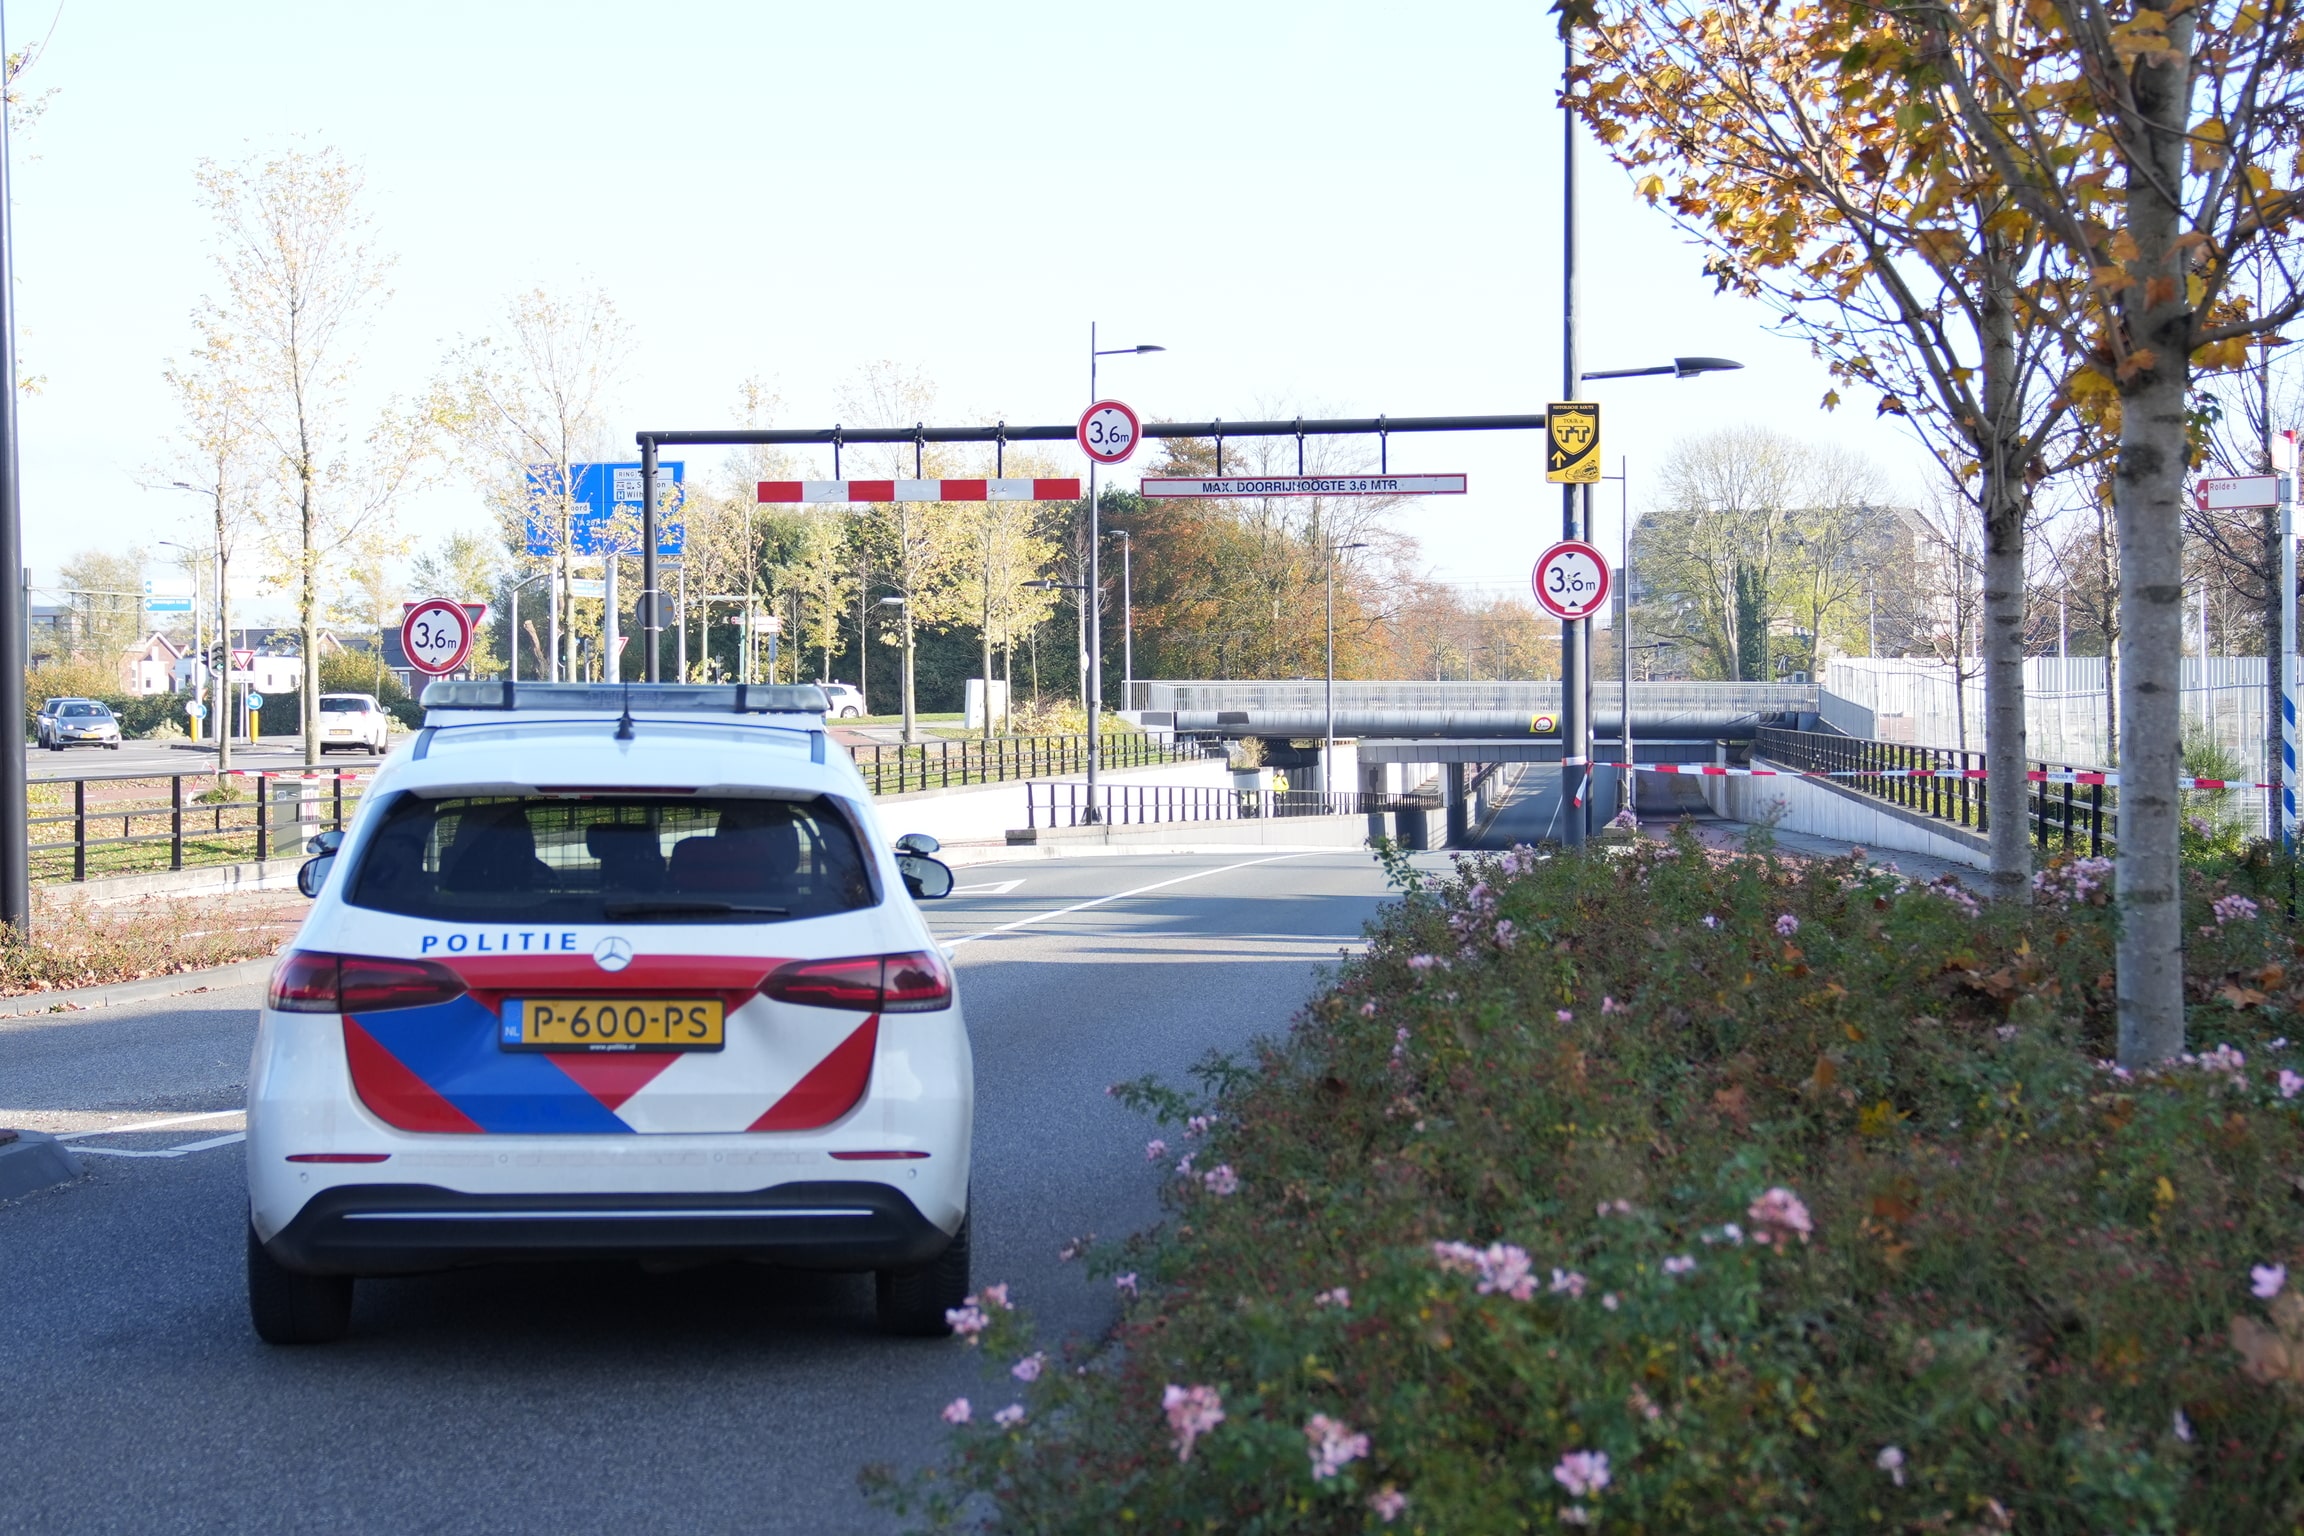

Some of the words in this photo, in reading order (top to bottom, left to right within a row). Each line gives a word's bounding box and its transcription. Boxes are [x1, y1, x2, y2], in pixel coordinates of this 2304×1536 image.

[1556, 425, 1591, 444] TT
[1202, 482, 1233, 493] MAX.
[1237, 480, 1346, 493] DOORRIJHOOGTE
[2209, 482, 2230, 491] Rolde
[421, 932, 577, 954] POLITIE
[534, 1005, 708, 1038] P-600-PS
[504, 1026, 520, 1037] NL
